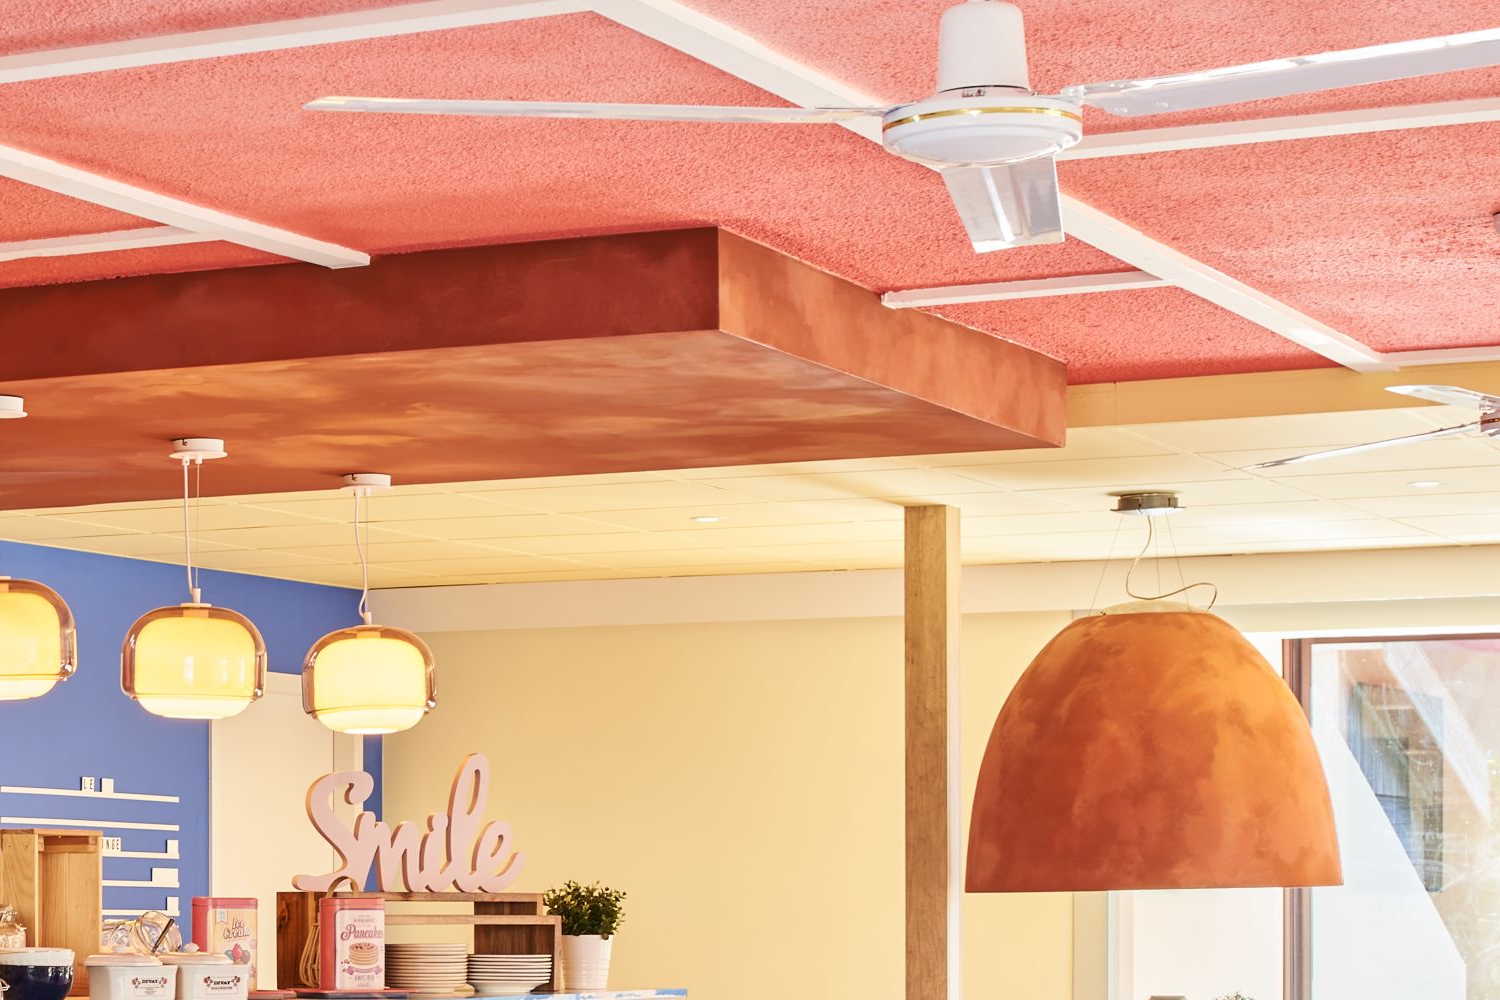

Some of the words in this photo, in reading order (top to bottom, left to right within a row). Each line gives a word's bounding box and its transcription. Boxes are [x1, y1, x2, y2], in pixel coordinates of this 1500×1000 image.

[83, 778, 93, 790] LE
[292, 752, 526, 893] Smile
[231, 917, 245, 929] Ice
